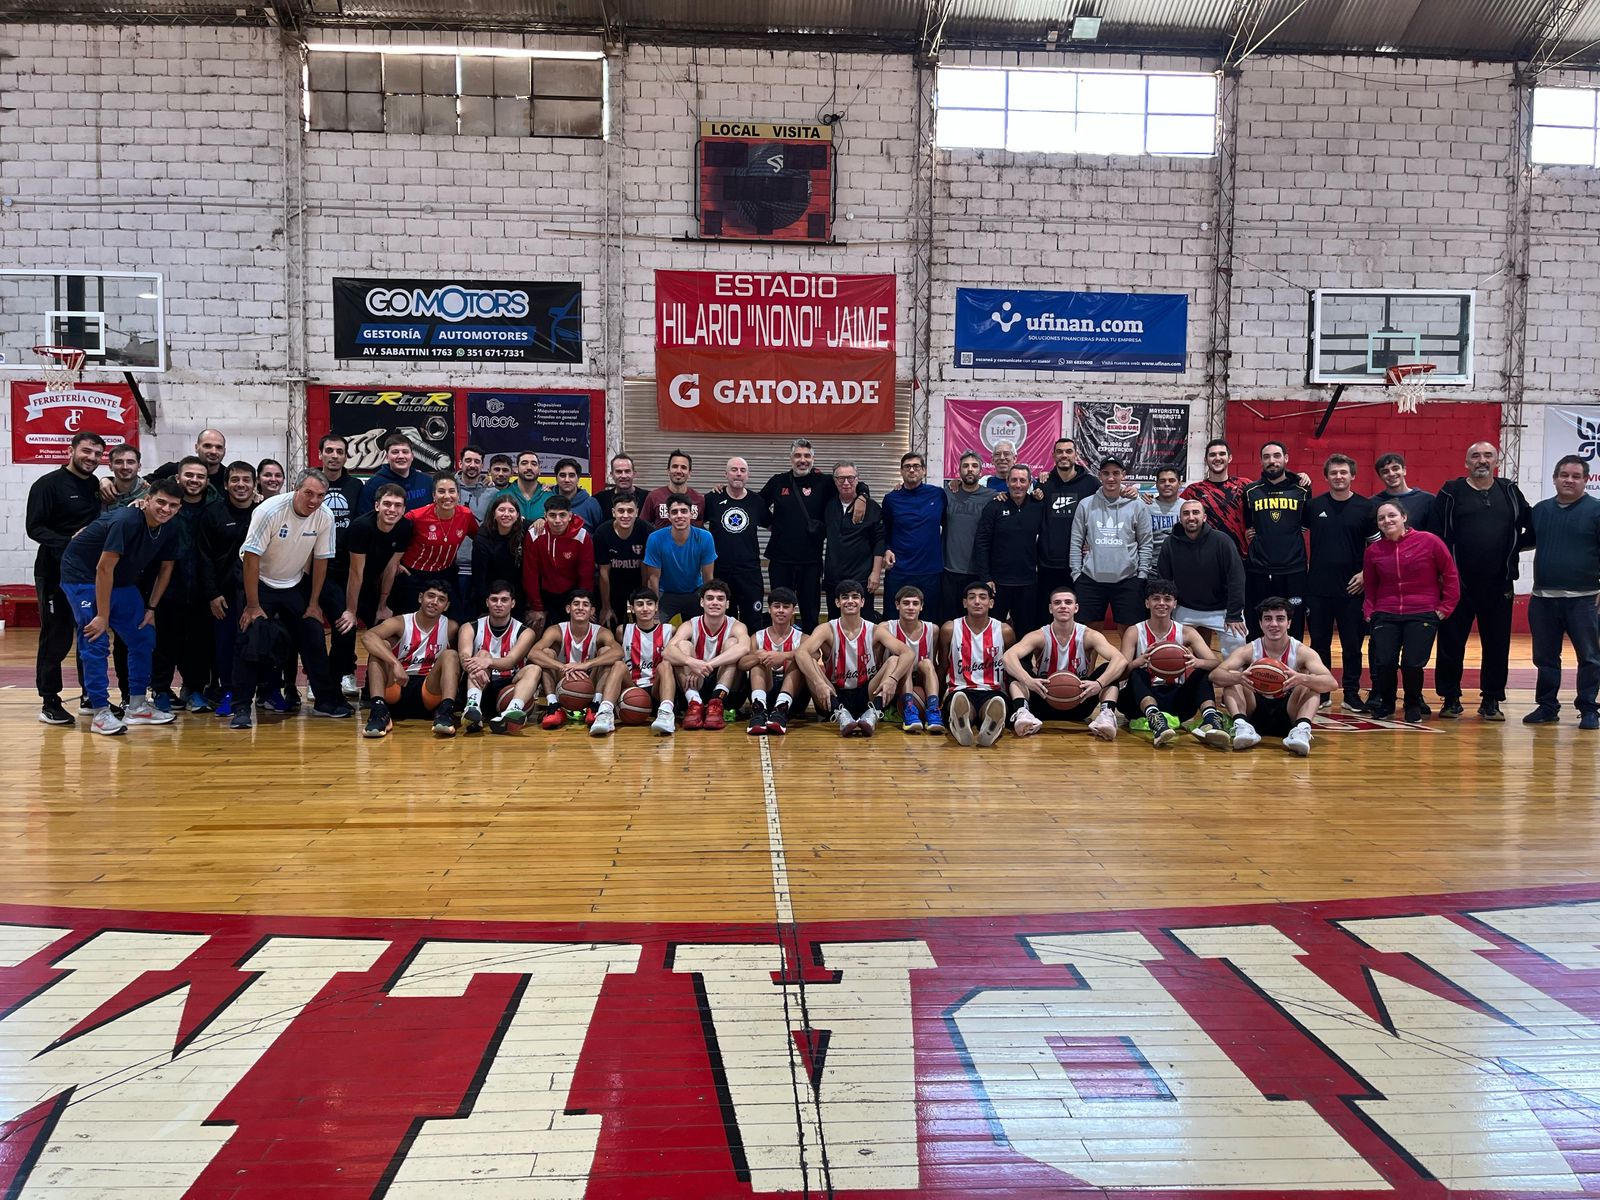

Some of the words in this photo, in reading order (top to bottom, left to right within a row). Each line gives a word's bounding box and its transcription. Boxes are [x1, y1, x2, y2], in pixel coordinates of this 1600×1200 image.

[711, 123, 761, 137] LOCAL
[772, 125, 821, 139] VISITA
[715, 274, 837, 298] ESTADIO
[662, 302, 741, 346] HILARIO
[747, 304, 822, 347] "NONO"
[826, 305, 889, 348] JAIME
[1026, 313, 1144, 334] ufinan.com
[363, 328, 422, 339] GESTORÍA
[438, 330, 528, 341] AUTOMOTORES
[363, 347, 379, 356] AV.
[380, 347, 429, 356] SABATTINI
[431, 348, 453, 356] 1763
[466, 349, 483, 357] 351
[484, 349, 525, 357] 671-7331
[669, 373, 700, 408] G
[713, 379, 879, 404] GATORADE
[33, 393, 87, 407] FERRETERÍA
[88, 395, 118, 408] CONTE
[1254, 497, 1299, 512] HINDU
[1094, 537, 1123, 546] adidas
[1254, 671, 1279, 680] molten
